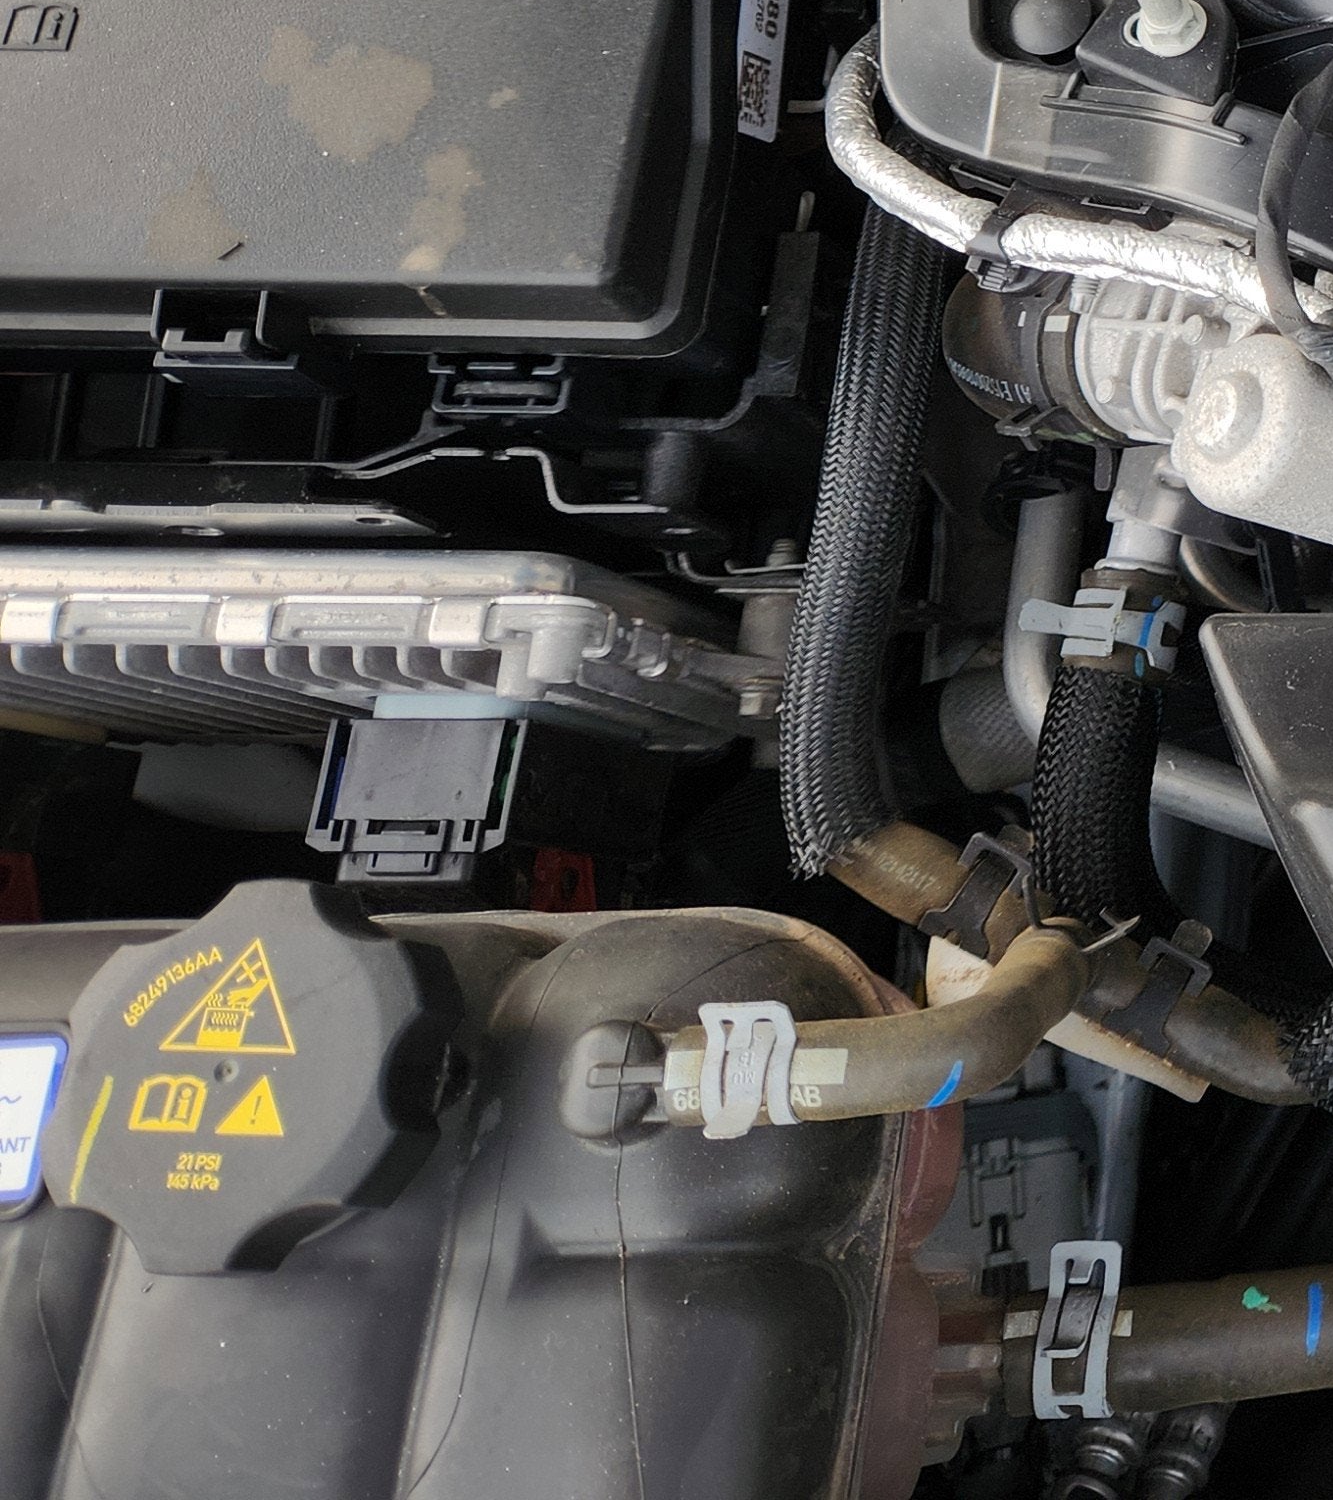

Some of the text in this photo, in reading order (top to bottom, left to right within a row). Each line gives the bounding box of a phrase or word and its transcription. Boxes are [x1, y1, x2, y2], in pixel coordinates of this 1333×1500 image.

[123, 947, 223, 1027] 68249136AA
[177, 1154, 223, 1171] 21 PSI
[189, 1174, 220, 1192] kPa
